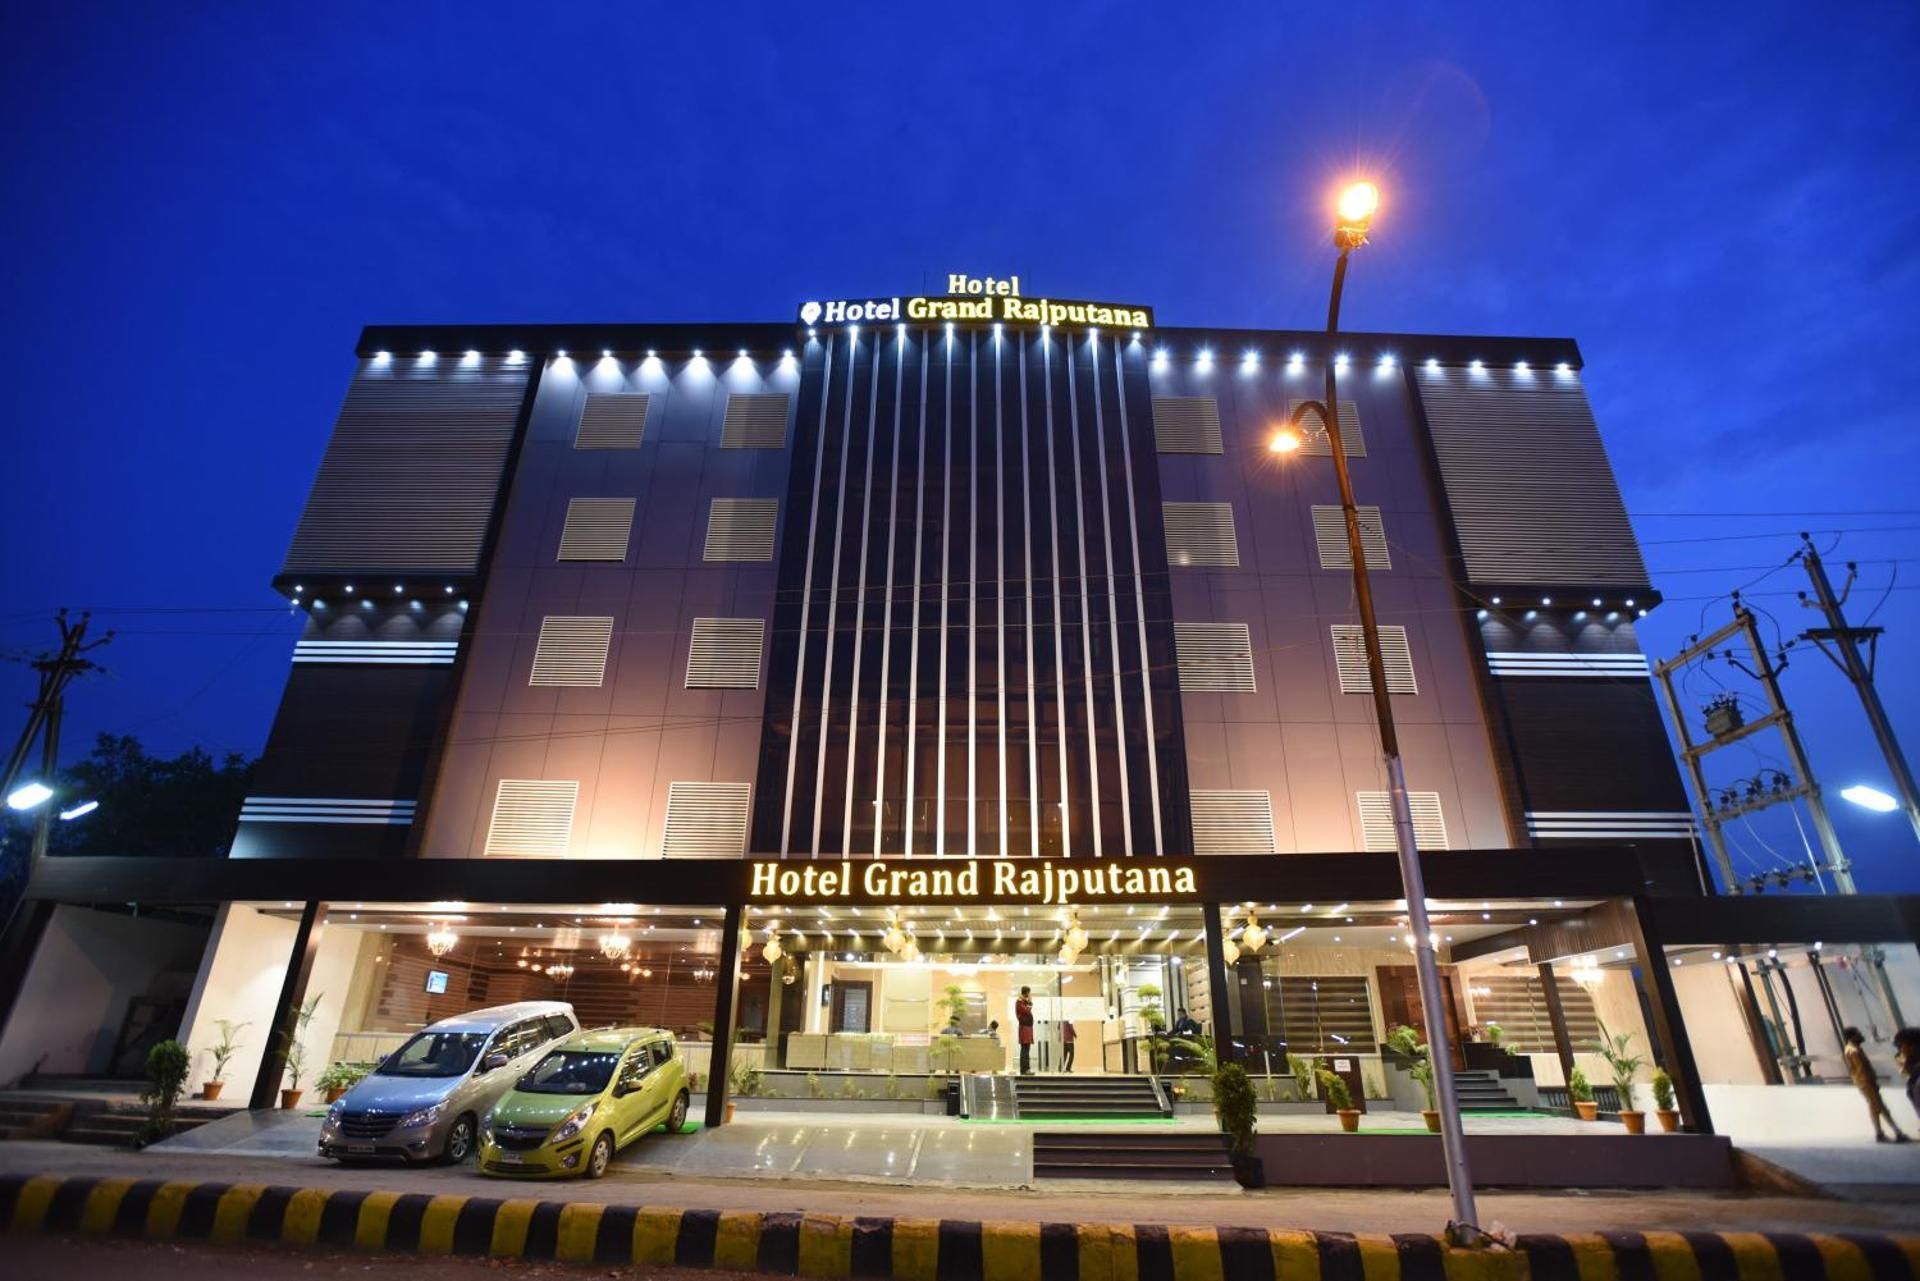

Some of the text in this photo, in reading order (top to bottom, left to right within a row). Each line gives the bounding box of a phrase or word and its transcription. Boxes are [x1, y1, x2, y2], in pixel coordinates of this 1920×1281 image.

[948, 274, 1019, 296] Hotel
[824, 297, 1149, 328] Hotel Grand Rajputana
[751, 862, 1197, 903] Hotel Grand Rajputana
